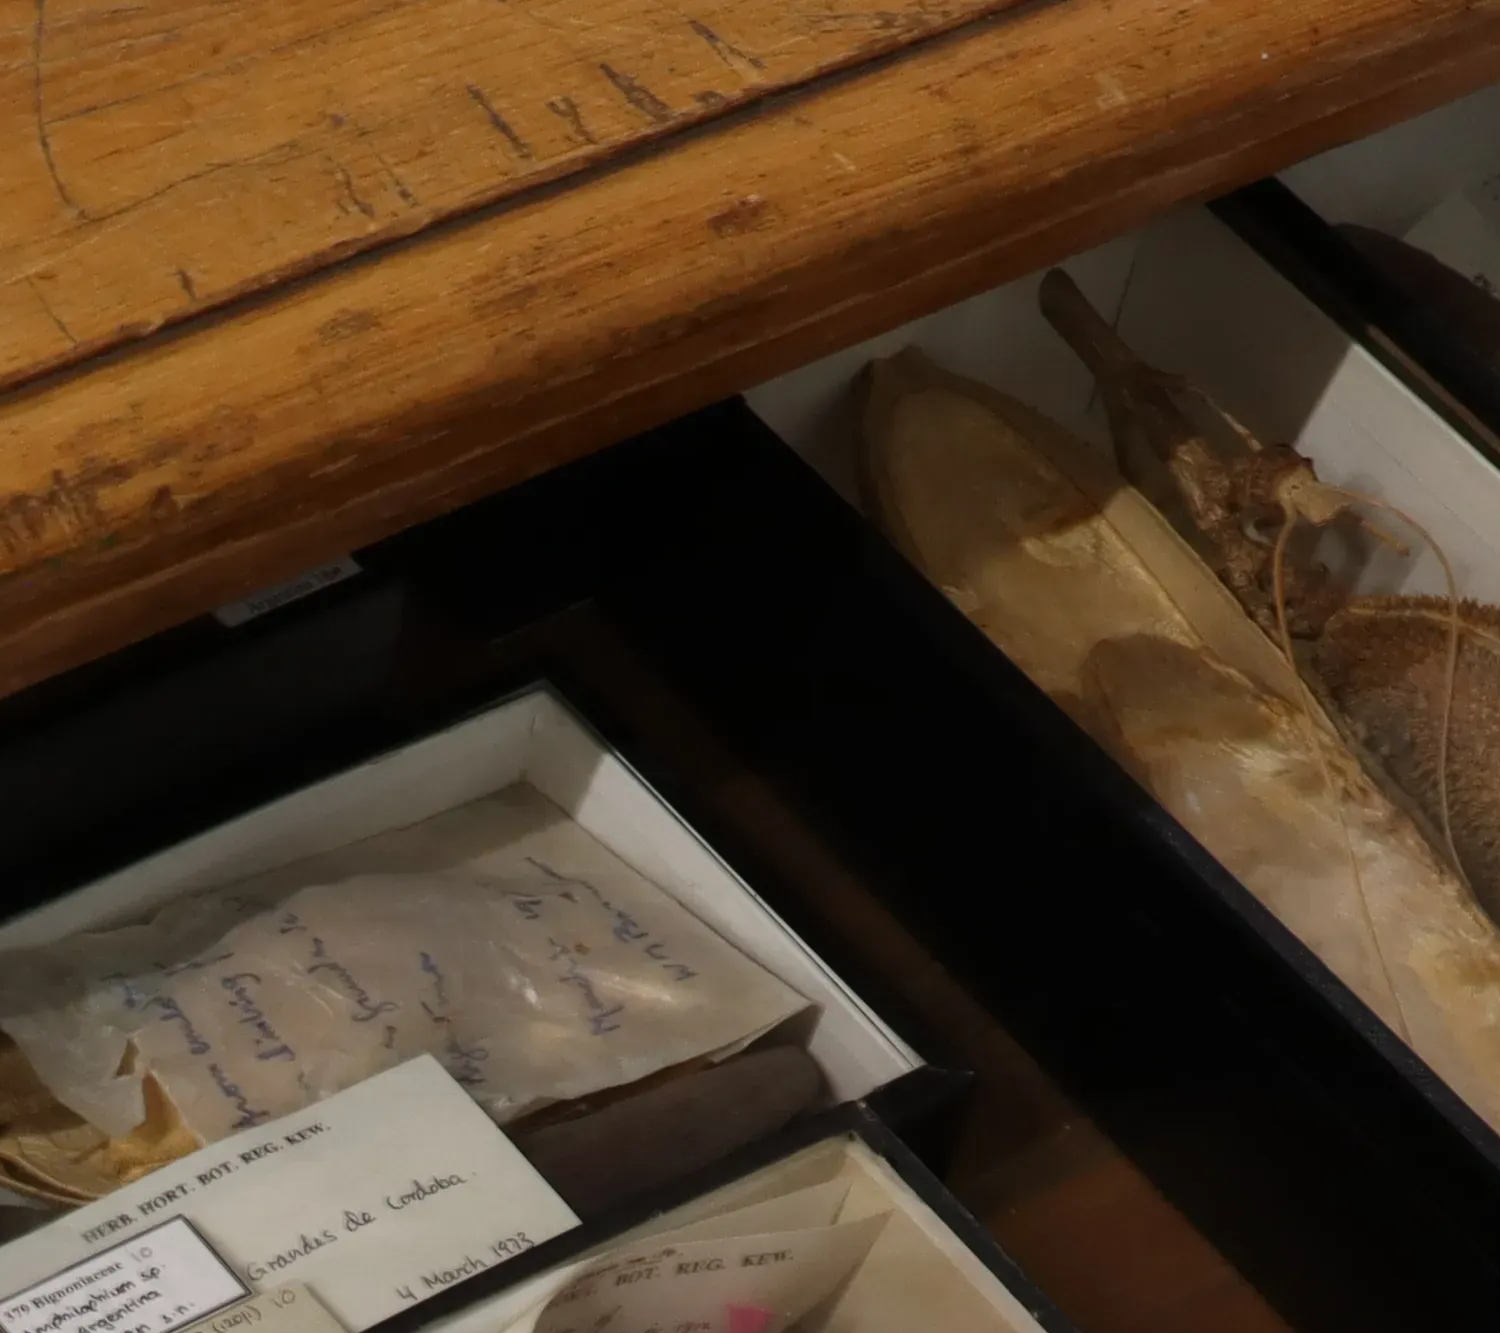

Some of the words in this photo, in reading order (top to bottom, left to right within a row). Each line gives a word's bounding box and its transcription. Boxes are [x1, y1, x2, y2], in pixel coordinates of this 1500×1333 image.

[81, 1214, 134, 1243] HERB.
[137, 1184, 188, 1216] HORT.
[196, 1161, 232, 1186] BOT.
[238, 1142, 279, 1165] REG.
[283, 1124, 324, 1146] KEW.
[241, 1230, 338, 1284] Grandes
[421, 1256, 490, 1289] March
[4, 1303, 31, 1320] 379
[30, 1262, 122, 1309] Bignoniaceae
